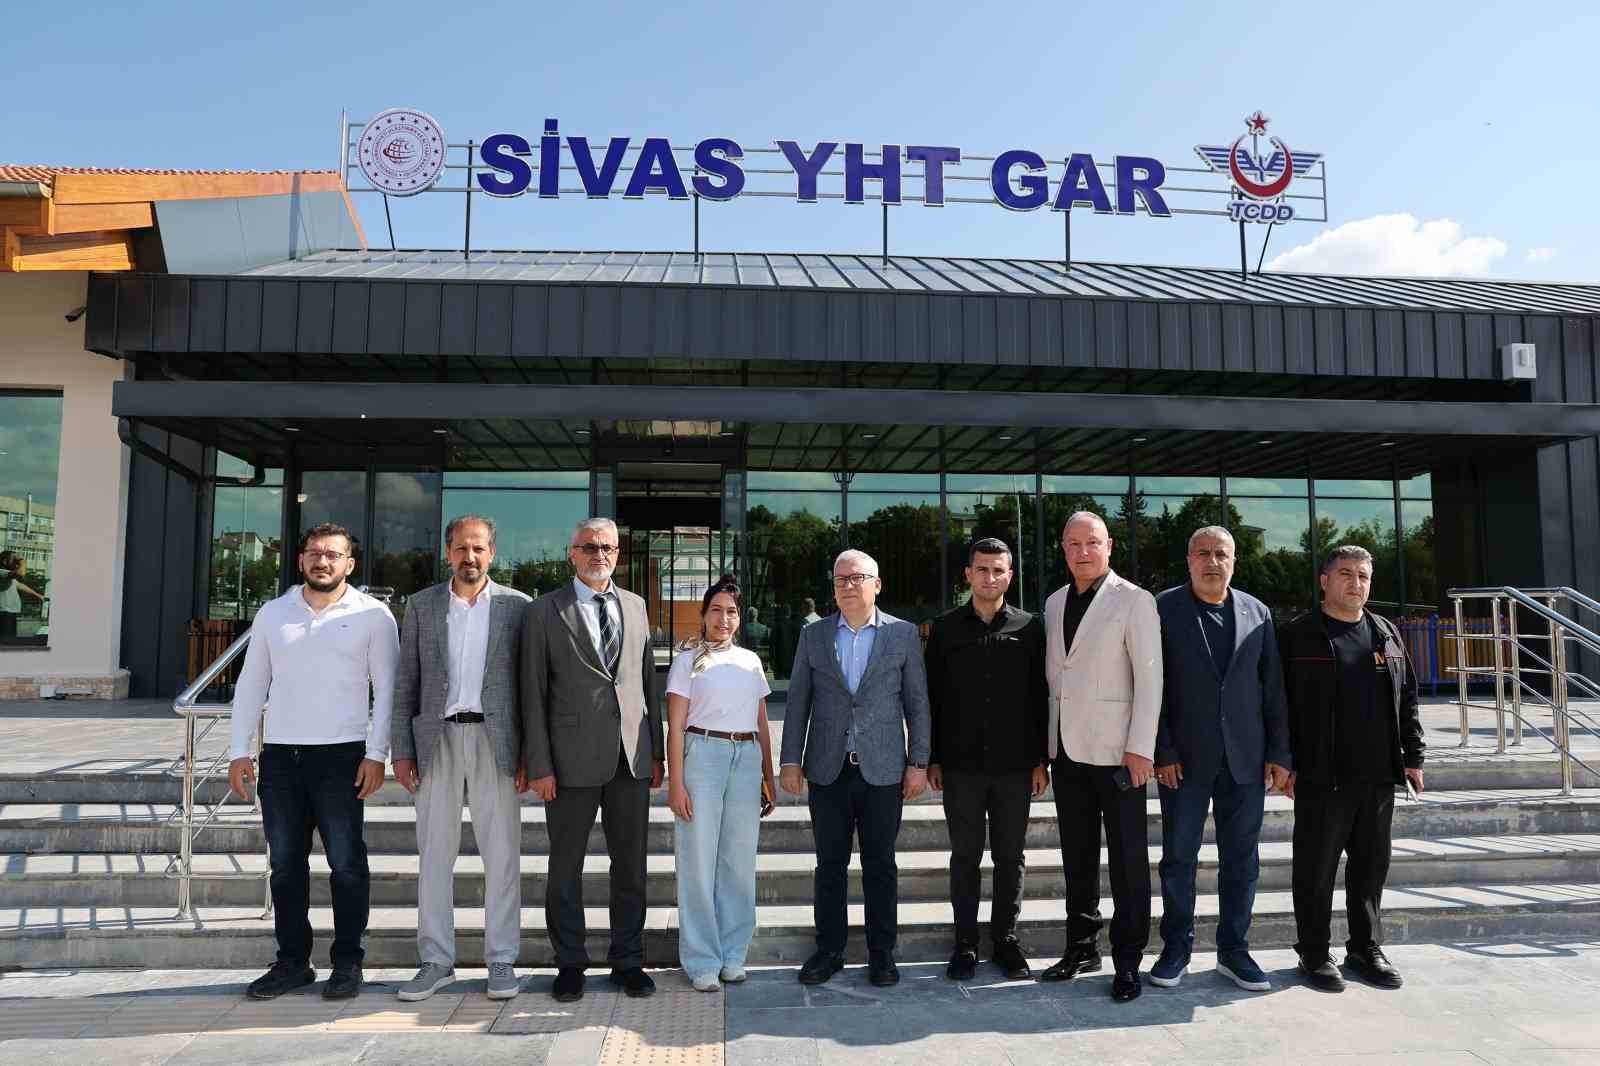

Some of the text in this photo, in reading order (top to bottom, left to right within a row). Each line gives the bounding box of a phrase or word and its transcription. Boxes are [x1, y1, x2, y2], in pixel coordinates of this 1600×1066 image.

[477, 119, 745, 200] SİVAS
[776, 141, 961, 206] YHT
[991, 150, 1170, 216] GAR
[1232, 203, 1294, 221] TCDD
